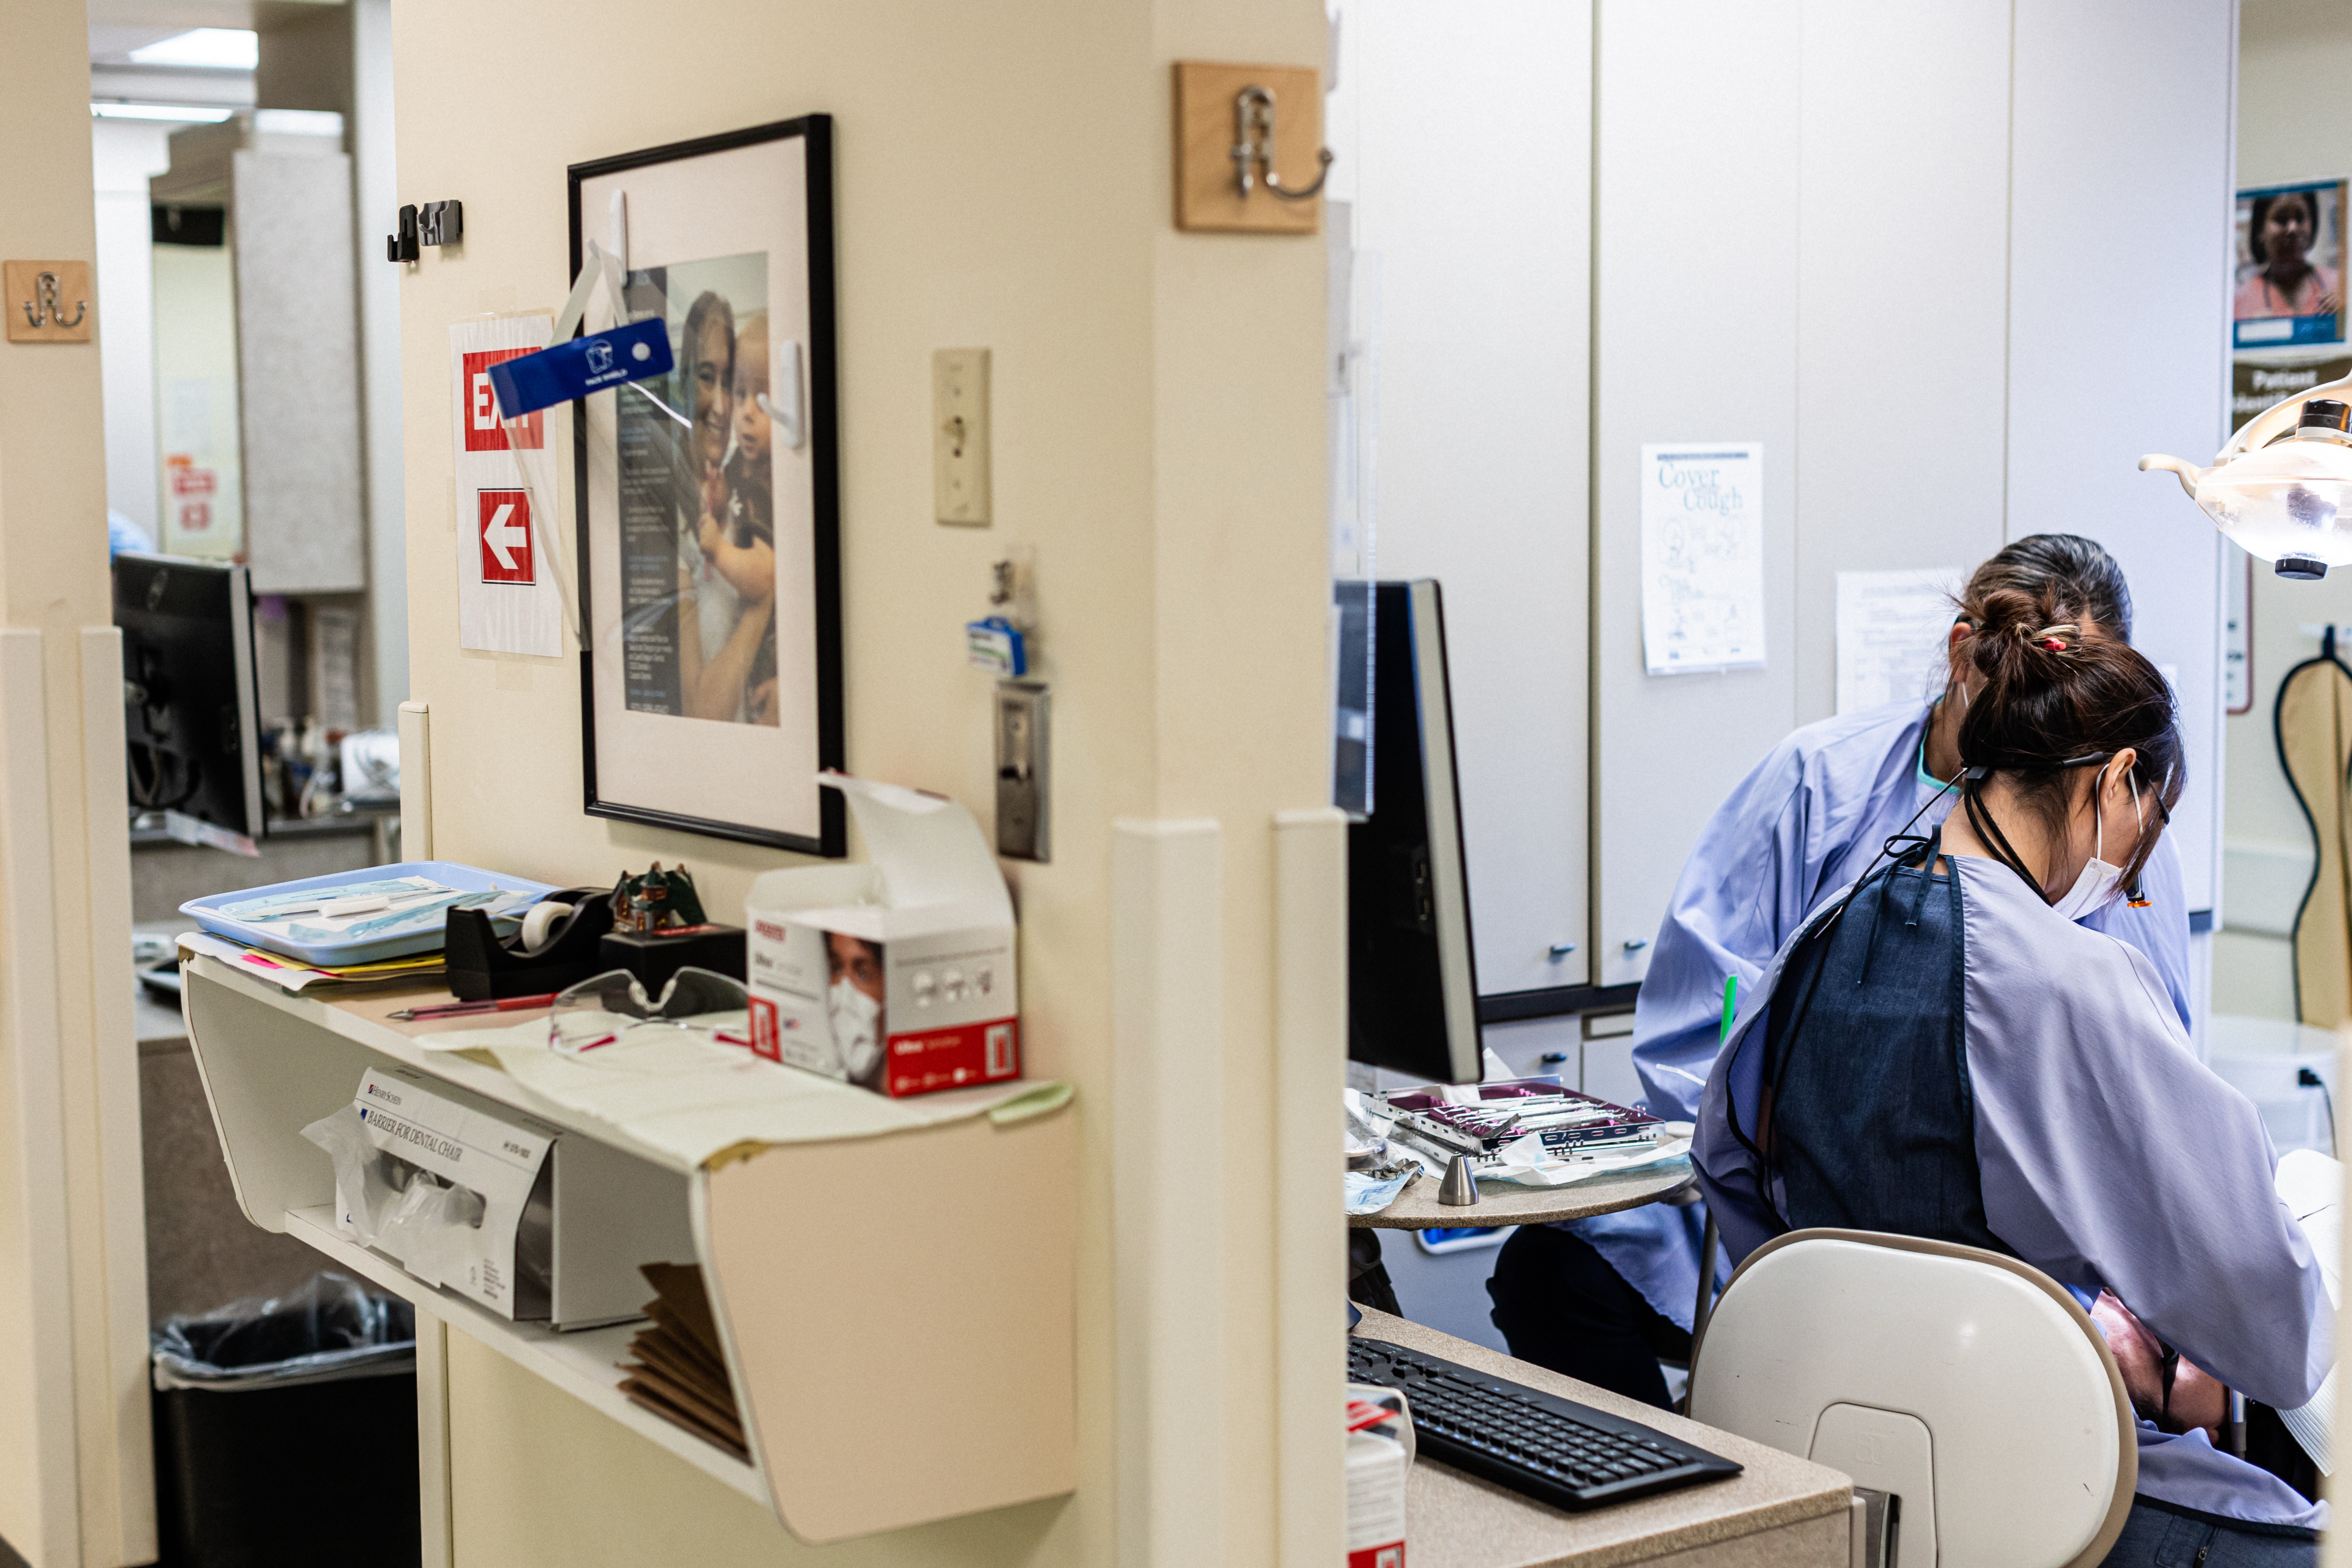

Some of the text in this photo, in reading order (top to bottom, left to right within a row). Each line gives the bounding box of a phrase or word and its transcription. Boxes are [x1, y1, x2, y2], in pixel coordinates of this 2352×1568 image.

[1659, 462, 1720, 489] Cover
[1684, 486, 1743, 517] Cough
[367, 1111, 463, 1162] BARRIER FOR DENTAL CHAIR
